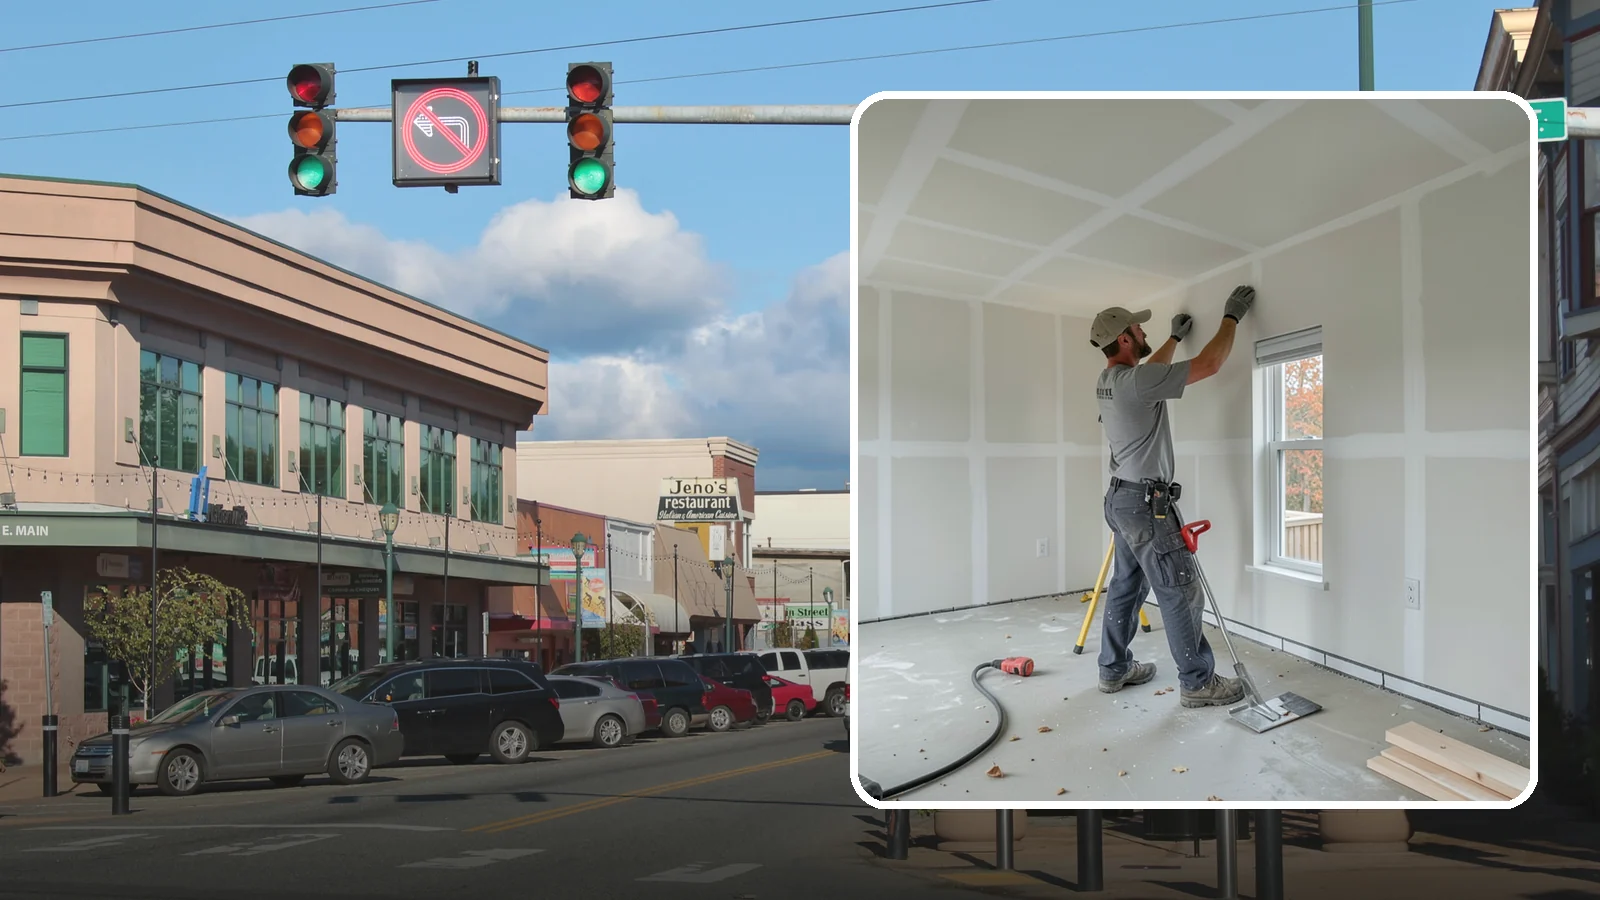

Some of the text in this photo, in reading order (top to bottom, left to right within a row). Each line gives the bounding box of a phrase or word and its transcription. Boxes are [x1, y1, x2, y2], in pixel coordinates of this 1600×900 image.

[670, 480, 727, 494] Jeno's
[665, 496, 731, 509] restaurant
[659, 510, 681, 519] Italian
[686, 510, 715, 519] American
[715, 510, 738, 519] Cuisine
[2, 525, 49, 536] E. MAIN
[797, 607, 829, 617] Street
